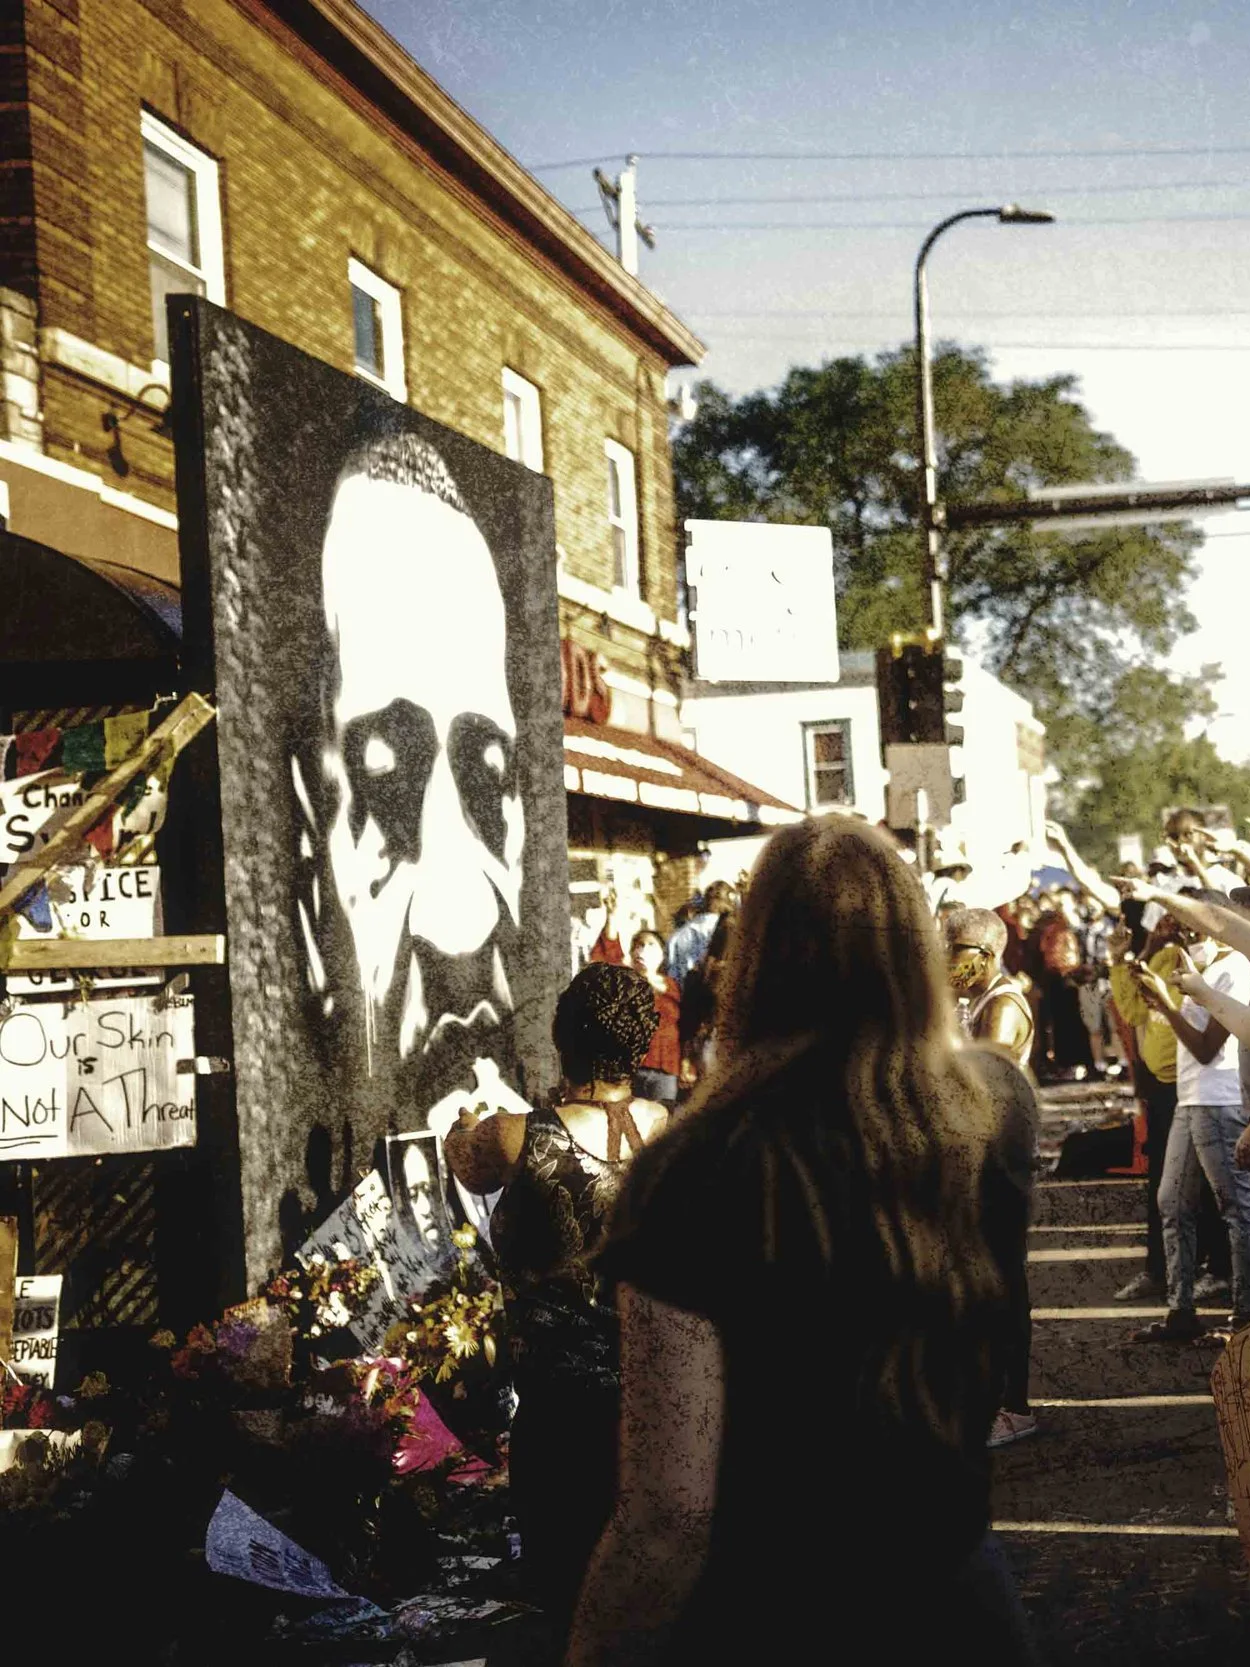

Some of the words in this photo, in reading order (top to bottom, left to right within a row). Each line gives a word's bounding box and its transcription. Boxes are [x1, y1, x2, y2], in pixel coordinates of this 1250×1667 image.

[22, 784, 91, 809] Chan
[0, 1012, 86, 1067] Our
[96, 1010, 174, 1050] Skin
[77, 1056, 98, 1076] is
[1, 1087, 61, 1133] Not
[70, 1086, 114, 1133] A
[102, 1067, 195, 1128] Threat
[11, 1337, 58, 1363] EPTABLE
